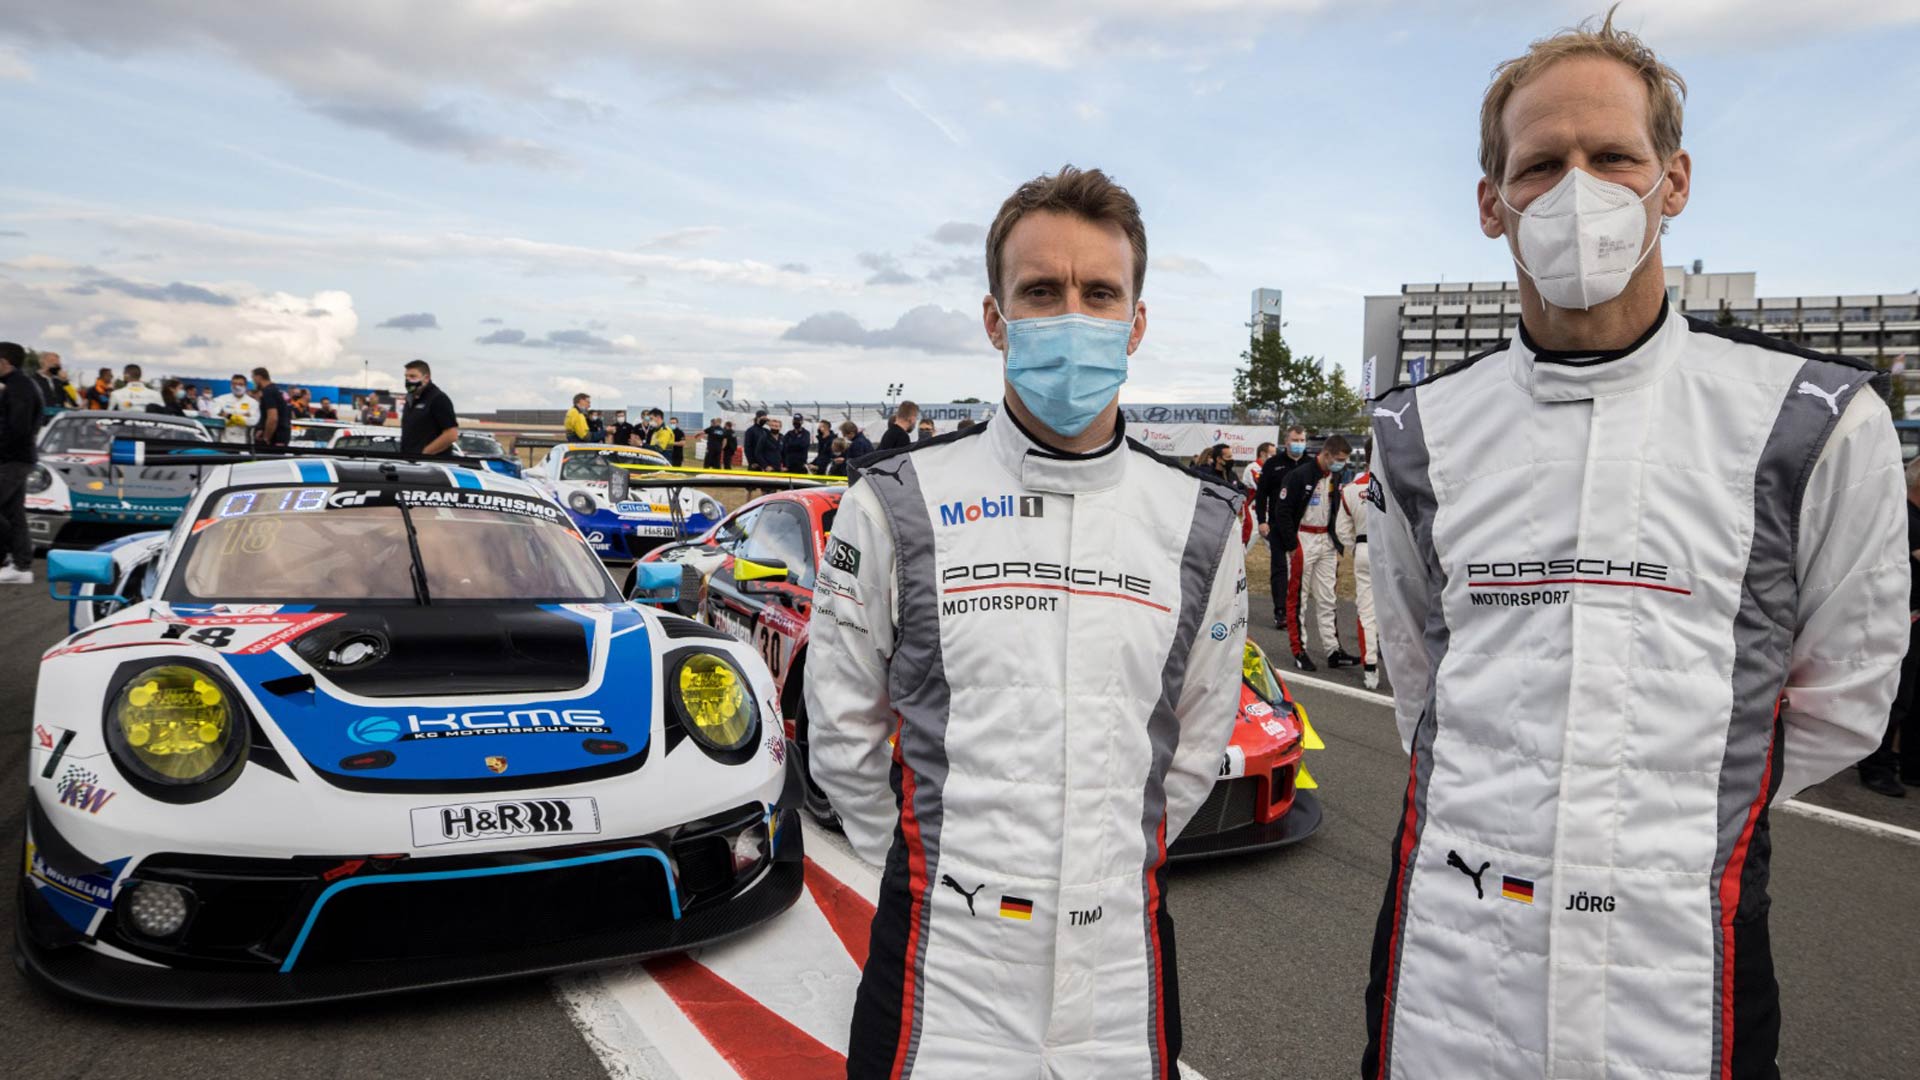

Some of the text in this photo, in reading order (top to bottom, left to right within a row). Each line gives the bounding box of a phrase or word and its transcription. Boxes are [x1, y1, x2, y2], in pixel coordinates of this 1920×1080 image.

[455, 502, 500, 512] DRIVING
[501, 507, 559, 524] SIMULATOR
[465, 493, 558, 518] TURISMO
[620, 503, 651, 513] Click
[940, 495, 1014, 527] Mobil
[942, 562, 1151, 595] PORSCHE
[1467, 559, 1669, 581] PORSCHE
[942, 595, 1059, 616] MOTORSPORT
[1469, 590, 1571, 608] MOTORSPORT
[192, 616, 290, 625] TOTAL
[160, 623, 236, 649] 18
[760, 625, 781, 679] 30
[408, 709, 606, 732] KCMG
[445, 726, 570, 737] MOTORGROUP
[575, 726, 610, 734] LTD.
[60, 778, 117, 815] KW
[442, 803, 526, 838] H&R
[45, 868, 111, 901] MICHELIN
[1565, 891, 1616, 912] JÖRG
[1069, 905, 1102, 926] TIMO
